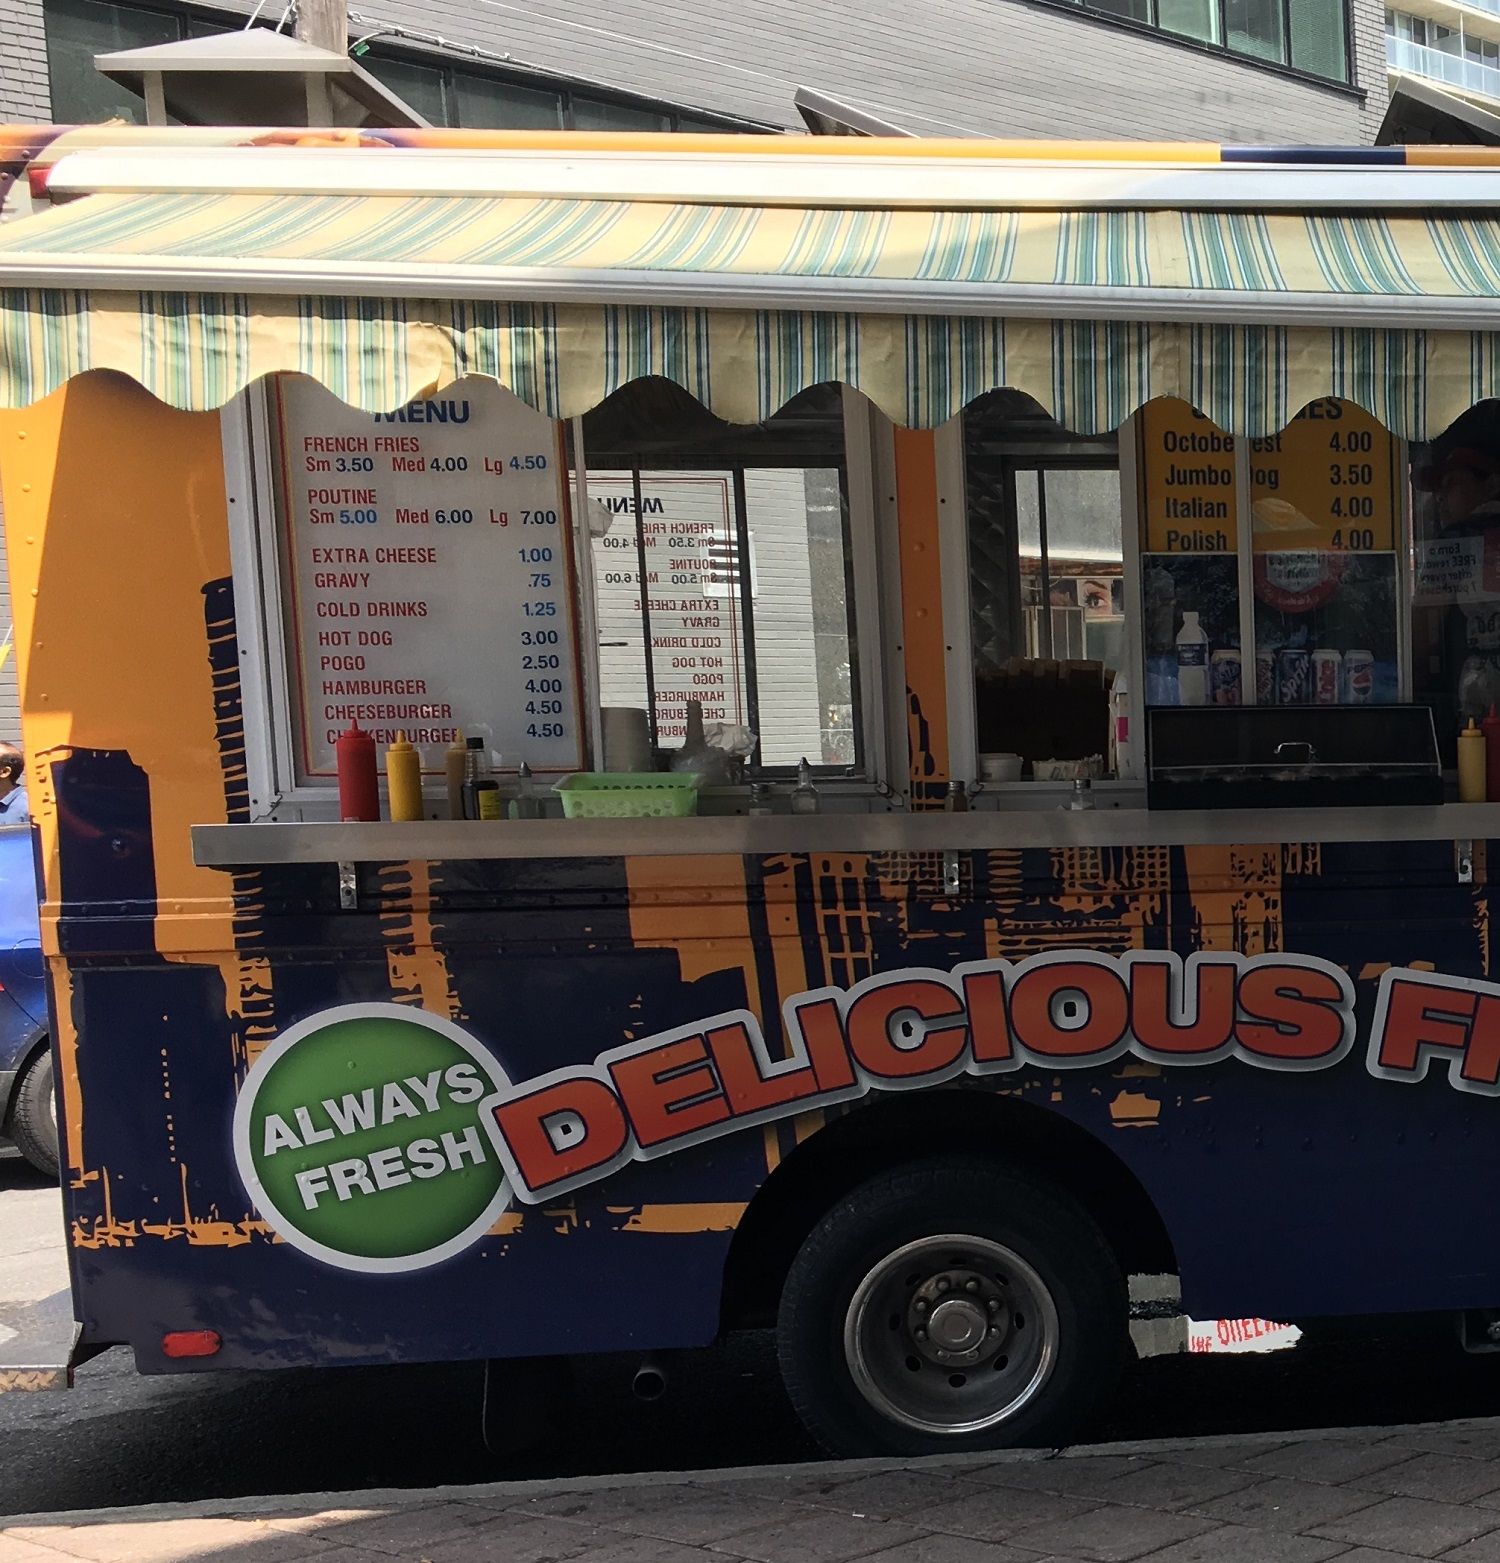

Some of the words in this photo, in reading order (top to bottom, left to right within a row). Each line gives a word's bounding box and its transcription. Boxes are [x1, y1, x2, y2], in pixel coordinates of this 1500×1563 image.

[374, 400, 470, 423] MENU
[304, 437, 368, 453] FRENCH
[374, 437, 420, 453] FRIES
[1164, 430, 1282, 453] Octobeest
[1329, 431, 1372, 453] 4.00
[306, 457, 331, 472] Sm
[335, 457, 374, 473] 3.50
[392, 457, 425, 472] Med
[430, 457, 468, 472] 4.00
[485, 457, 503, 475] Lg
[509, 455, 547, 471] 4.50
[1165, 464, 1232, 486] Jumbo
[1329, 464, 1373, 485] 3.50
[308, 489, 377, 504] POUTINE
[1165, 497, 1228, 518] Italian
[1330, 496, 1374, 518] 4.00
[309, 509, 335, 524] Sm
[339, 509, 378, 525] 5.00
[396, 509, 429, 524] Med
[435, 509, 473, 524] 6.00
[490, 509, 509, 527] Lg
[520, 510, 557, 525] 7.00
[1167, 530, 1228, 551] Polish
[1331, 529, 1374, 550] 4.00
[312, 548, 369, 563] EXTRA
[375, 548, 437, 563] CHEESE
[518, 547, 553, 563] 1.00
[314, 573, 371, 588] GRAVY
[528, 573, 551, 588] .75
[317, 602, 360, 617] COLD
[367, 602, 428, 617] DRINKS
[522, 602, 556, 617] 1.25
[318, 631, 352, 646] HOT
[358, 631, 393, 646] DOG
[521, 630, 559, 646] 3.00
[321, 656, 366, 671] POGO
[522, 655, 560, 670] 2.50
[322, 680, 427, 695] HAMBURGER
[525, 679, 563, 694] 4.00
[324, 703, 452, 720] CHEESEBURGER
[525, 700, 563, 715] 4.50
[526, 723, 564, 738] 4.50
[490, 955, 1348, 1194] DELICIOUS
[263, 1063, 485, 1157] ALWAYS
[295, 1126, 487, 1211] FRESH
